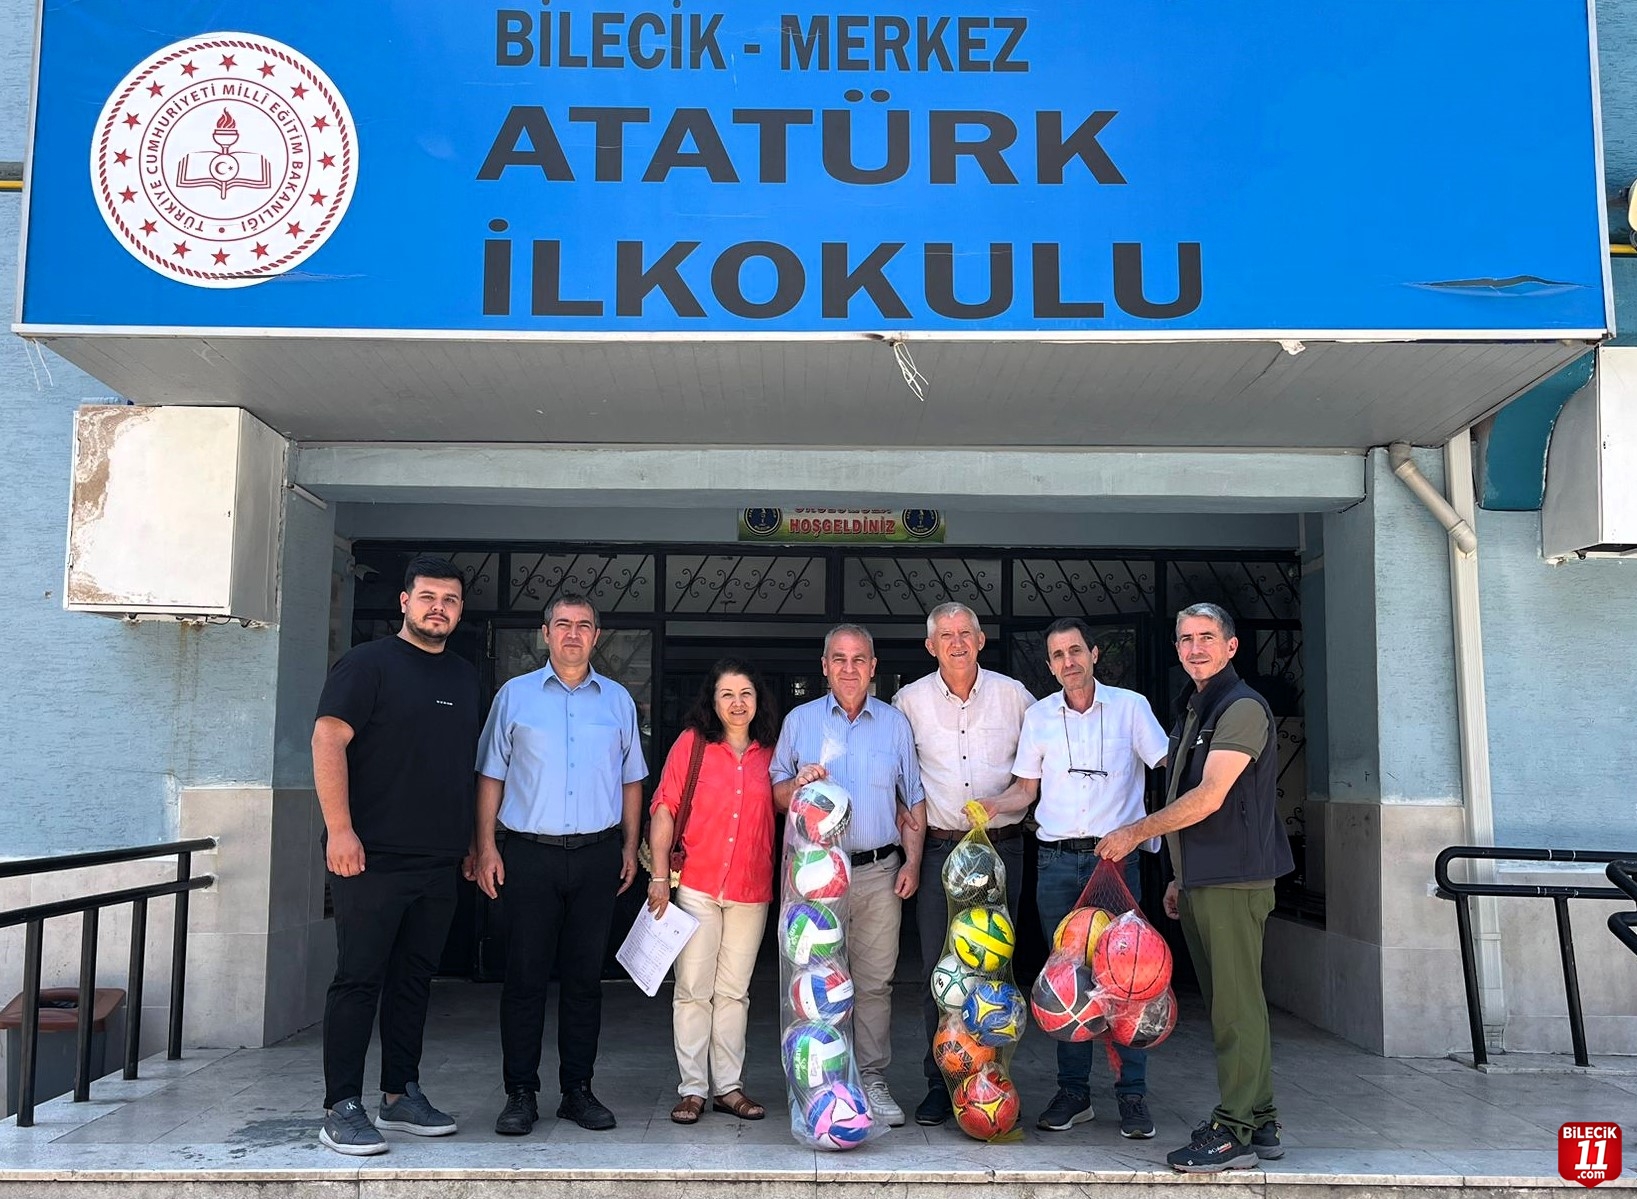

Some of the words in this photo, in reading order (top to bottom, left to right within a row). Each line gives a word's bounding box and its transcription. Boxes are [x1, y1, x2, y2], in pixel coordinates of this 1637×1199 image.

[496, 0, 725, 70] BİLECİK
[781, 15, 1029, 72] MERKEZ
[147, 83, 216, 175] CUMHURİYETİ
[270, 102, 304, 153] EĞİTİM
[476, 90, 1128, 185] ATATÜRK
[149, 180, 204, 232] TÜRKİYE
[241, 161, 304, 232] BAKANLIĞI
[482, 219, 1203, 319] İLKOKULU
[789, 515, 896, 537] HOŞGELDİNİZ
